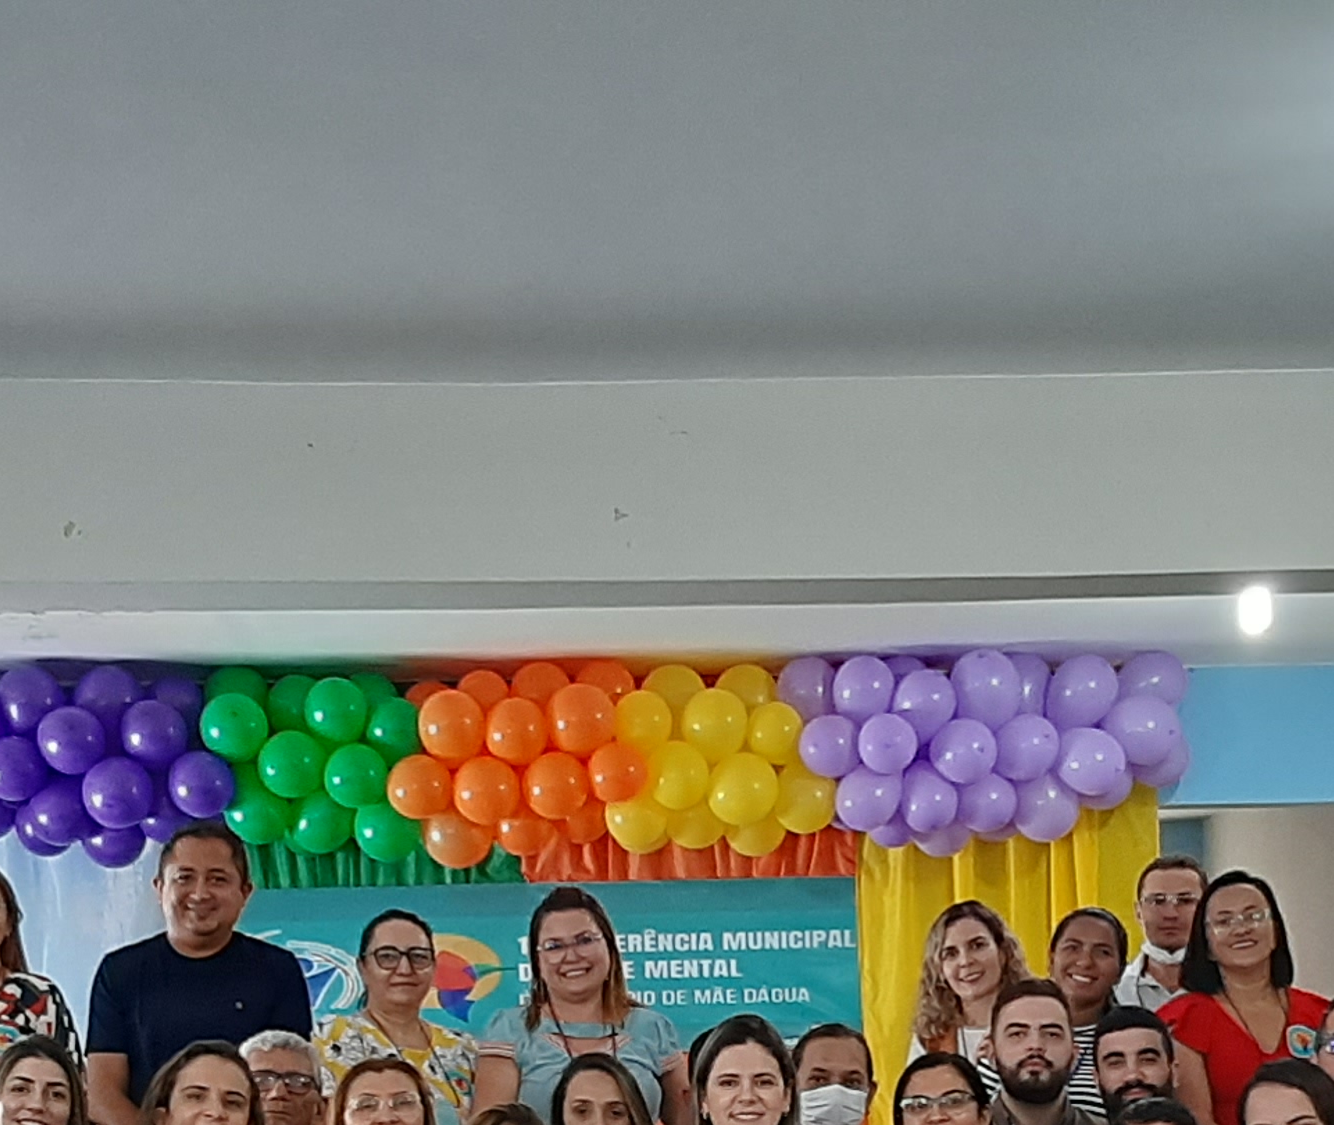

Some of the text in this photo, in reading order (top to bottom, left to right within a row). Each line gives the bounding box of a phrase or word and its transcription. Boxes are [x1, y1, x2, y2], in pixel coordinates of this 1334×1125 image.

[617, 929, 714, 953] ERÊNCIA
[722, 929, 857, 951] MUNICIPAL
[644, 958, 743, 979] MENTAL
[662, 989, 687, 1006] DE
[694, 986, 737, 1006] MÃE
